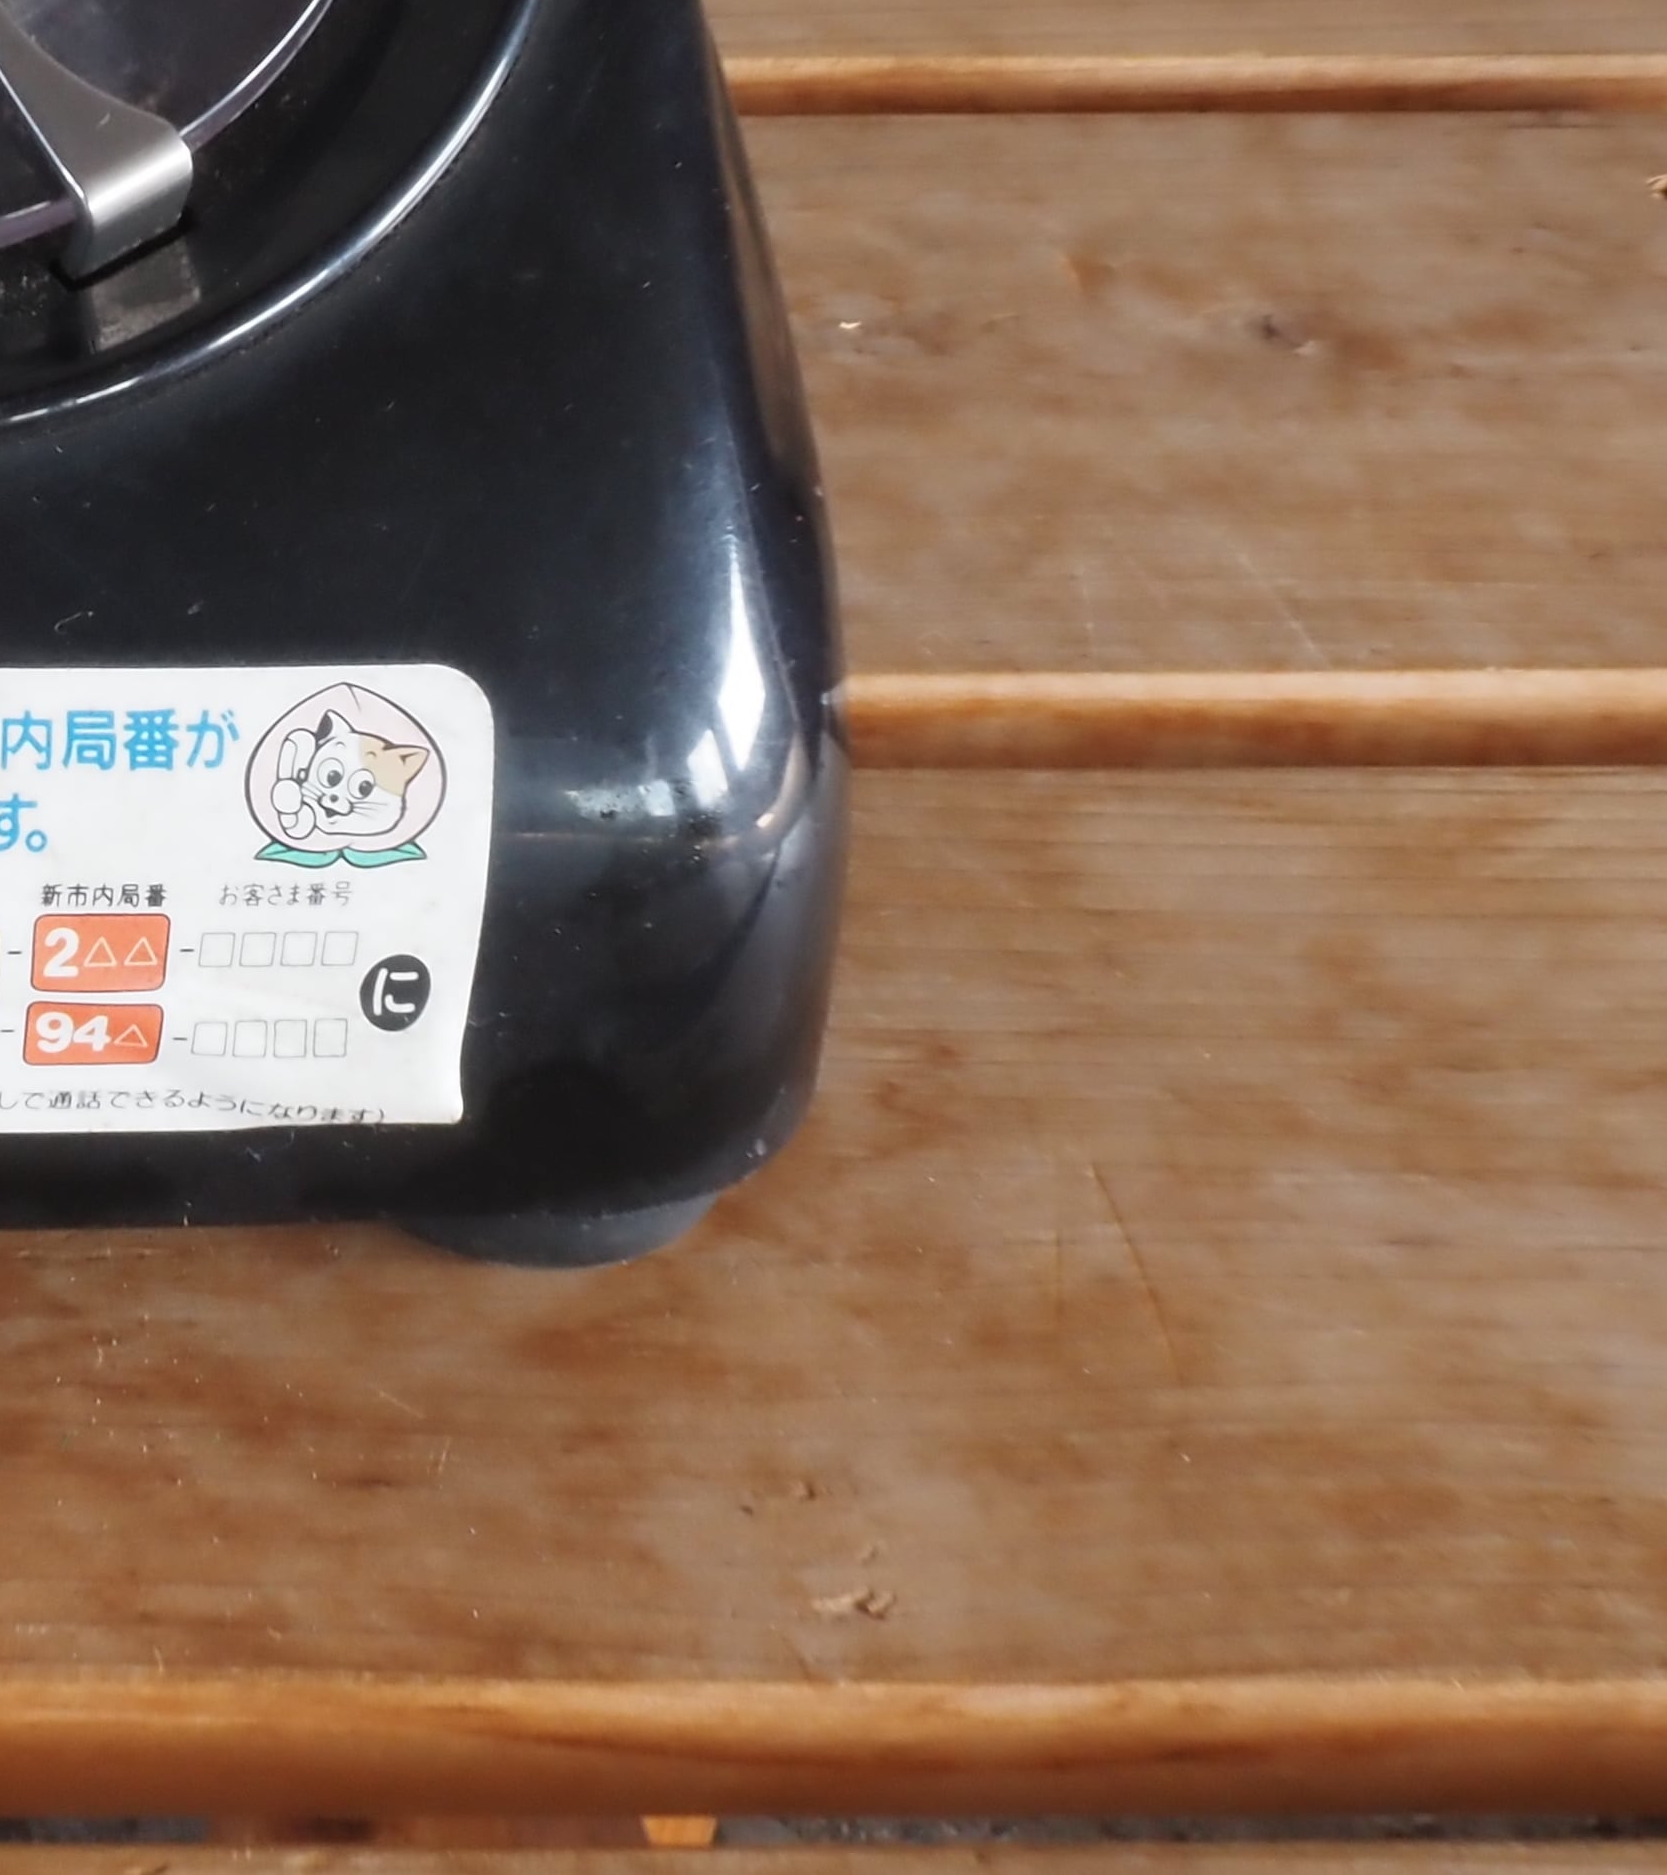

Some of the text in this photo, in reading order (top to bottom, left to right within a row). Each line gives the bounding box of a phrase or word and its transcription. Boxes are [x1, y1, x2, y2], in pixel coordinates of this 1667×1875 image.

[40, 882, 168, 909] 新市内局番
[372, 966, 420, 1017] に
